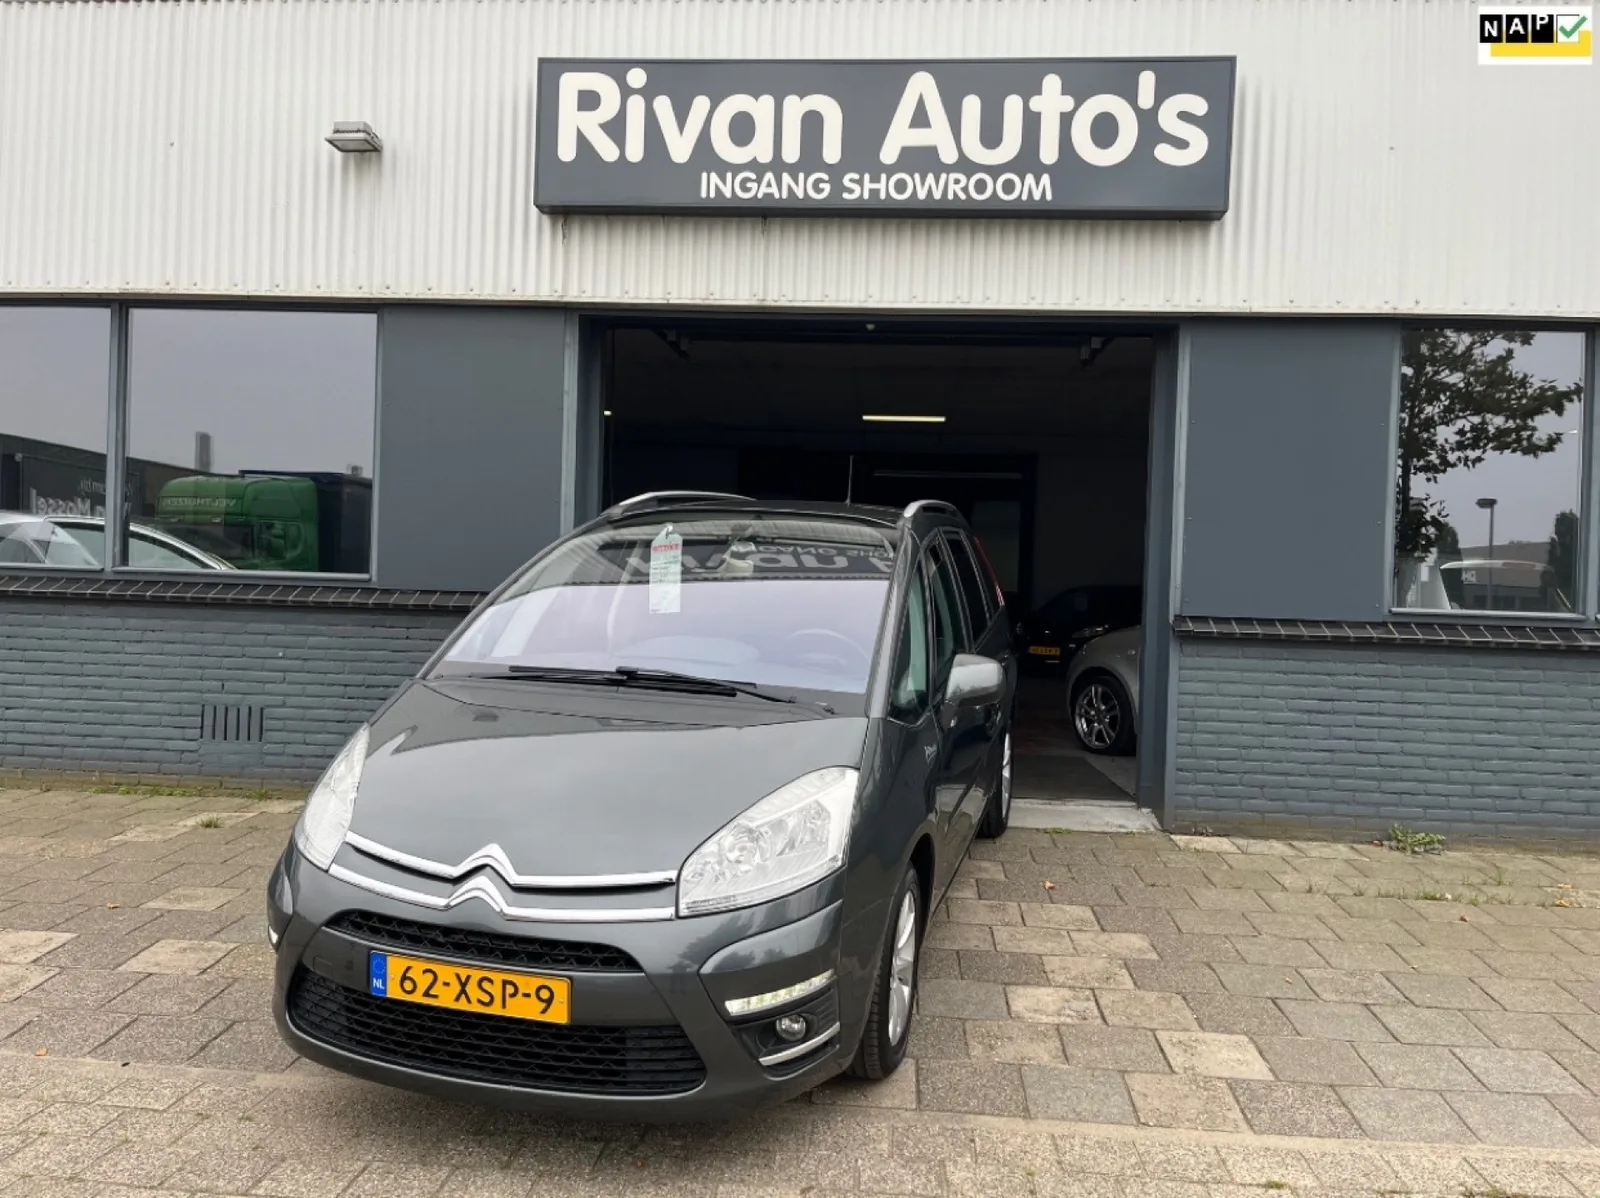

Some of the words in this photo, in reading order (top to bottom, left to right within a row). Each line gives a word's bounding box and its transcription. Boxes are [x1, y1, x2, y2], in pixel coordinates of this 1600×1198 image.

[558, 68, 842, 164] Rivan
[880, 71, 1208, 166] Auto's
[701, 171, 831, 199] INGANG
[842, 173, 1052, 201] SHOWROOM
[373, 977, 385, 990] NL
[400, 966, 555, 1014] 62-XSP-9
